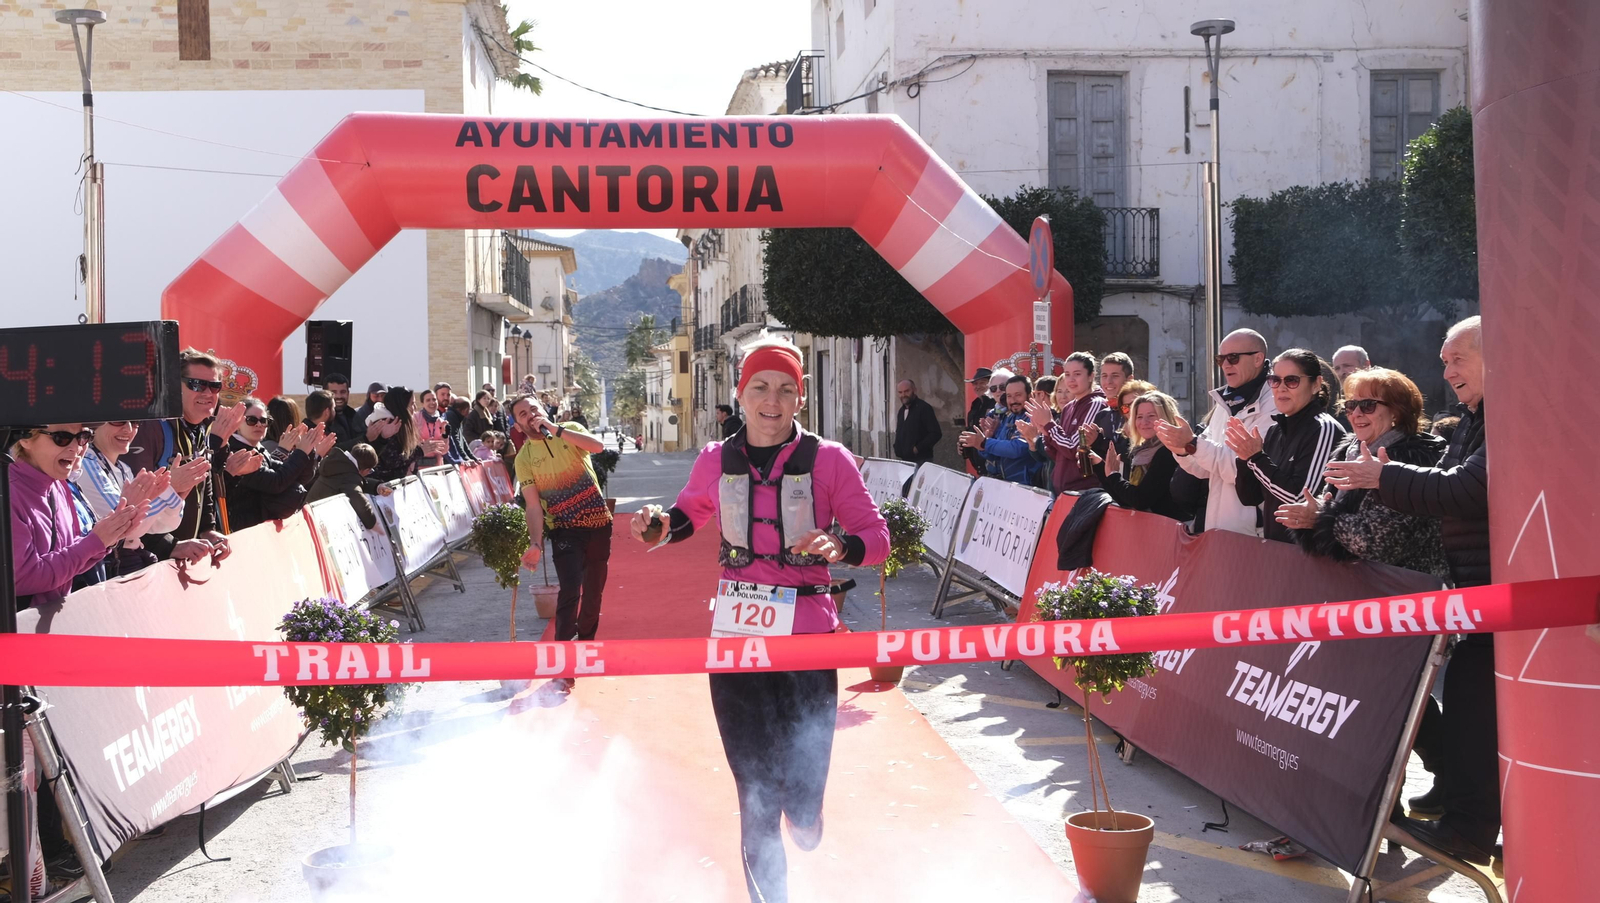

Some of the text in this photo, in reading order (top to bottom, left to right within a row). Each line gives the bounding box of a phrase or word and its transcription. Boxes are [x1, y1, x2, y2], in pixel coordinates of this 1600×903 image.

[455, 121, 794, 148] AYUNTAMIENTO
[466, 164, 783, 213] CANTORIA
[972, 518, 1032, 569] CANTORIA
[732, 602, 776, 628] 120
[253, 644, 431, 681] TRAIL
[535, 641, 605, 676] DE
[705, 636, 771, 670] LA
[876, 621, 1120, 663] POLVORA
[1225, 660, 1361, 740] TEAMERGY
[102, 695, 202, 793] TEAMERGY
[1236, 728, 1300, 771] www.teamergy.es
